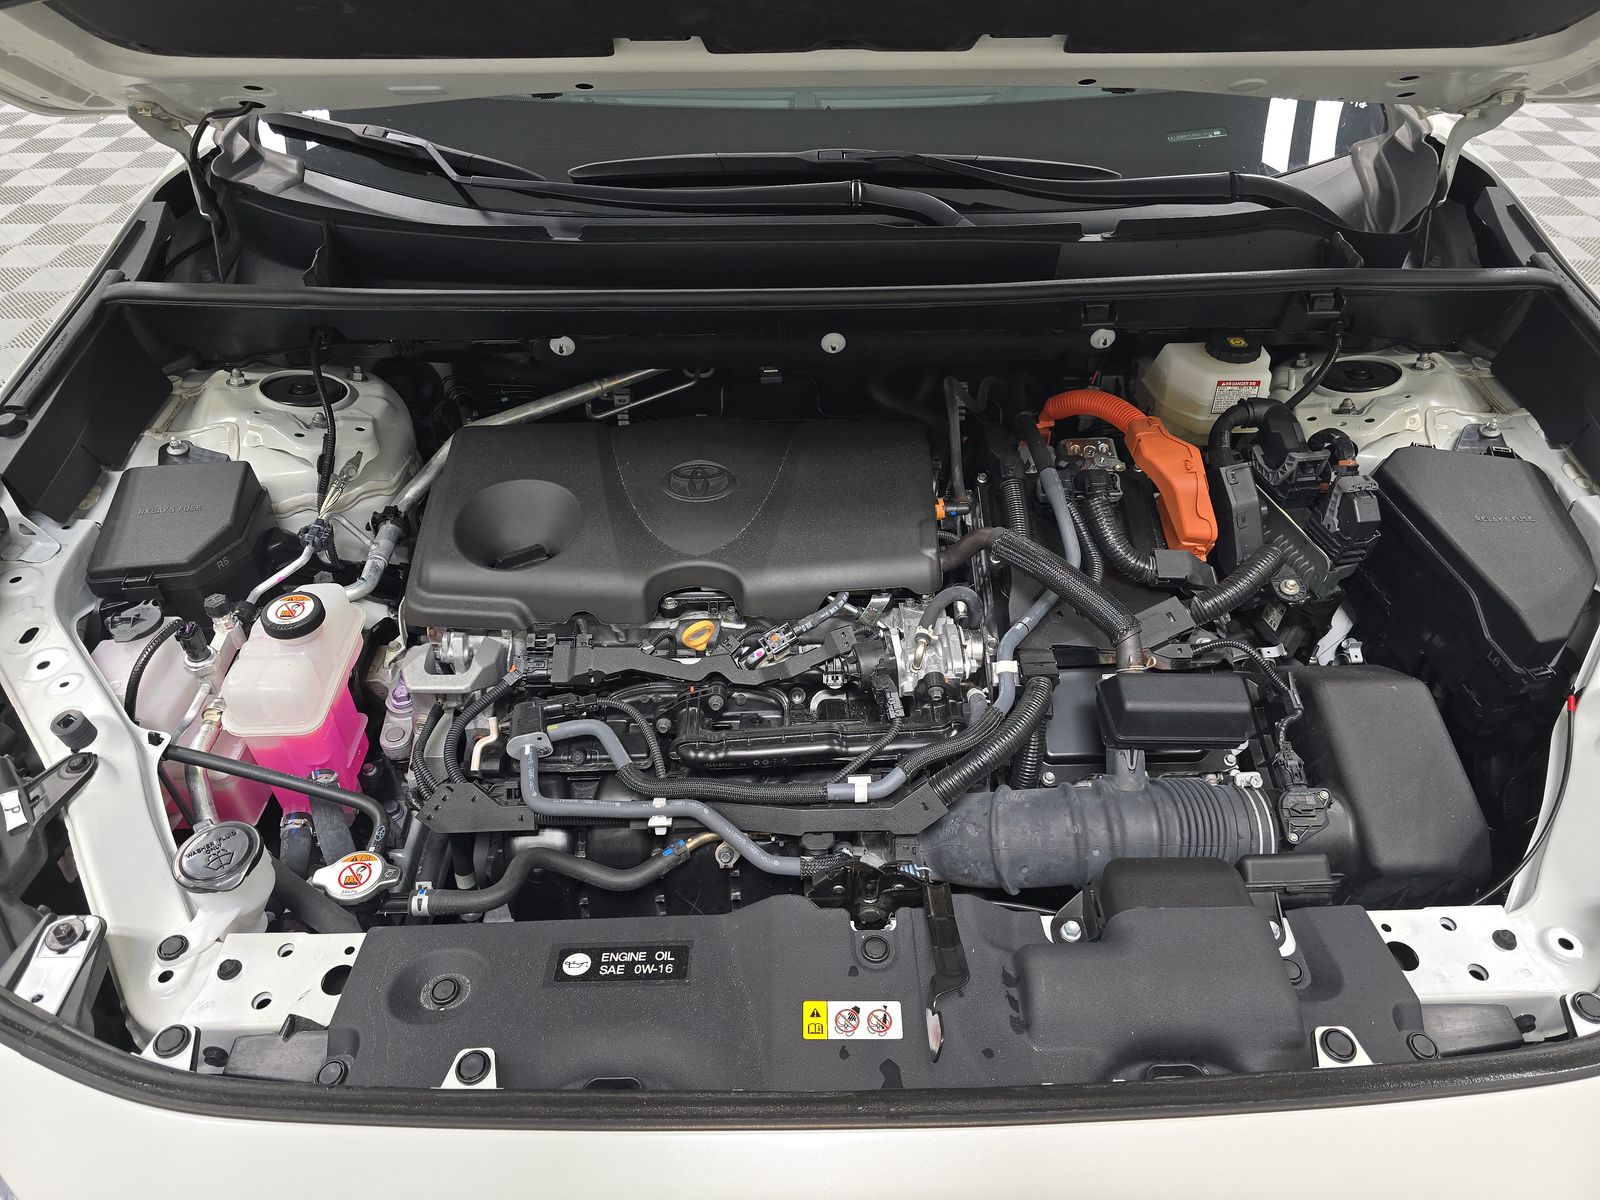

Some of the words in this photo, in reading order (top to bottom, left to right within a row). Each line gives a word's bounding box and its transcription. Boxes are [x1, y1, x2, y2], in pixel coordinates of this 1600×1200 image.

[216, 556, 230, 570] R5
[185, 841, 216, 859] WASHER
[219, 830, 237, 844] FLUID
[601, 951, 647, 963] ENGINE
[654, 950, 675, 961] OIL
[599, 964, 625, 975] SAE
[634, 963, 674, 974] 0W-16
